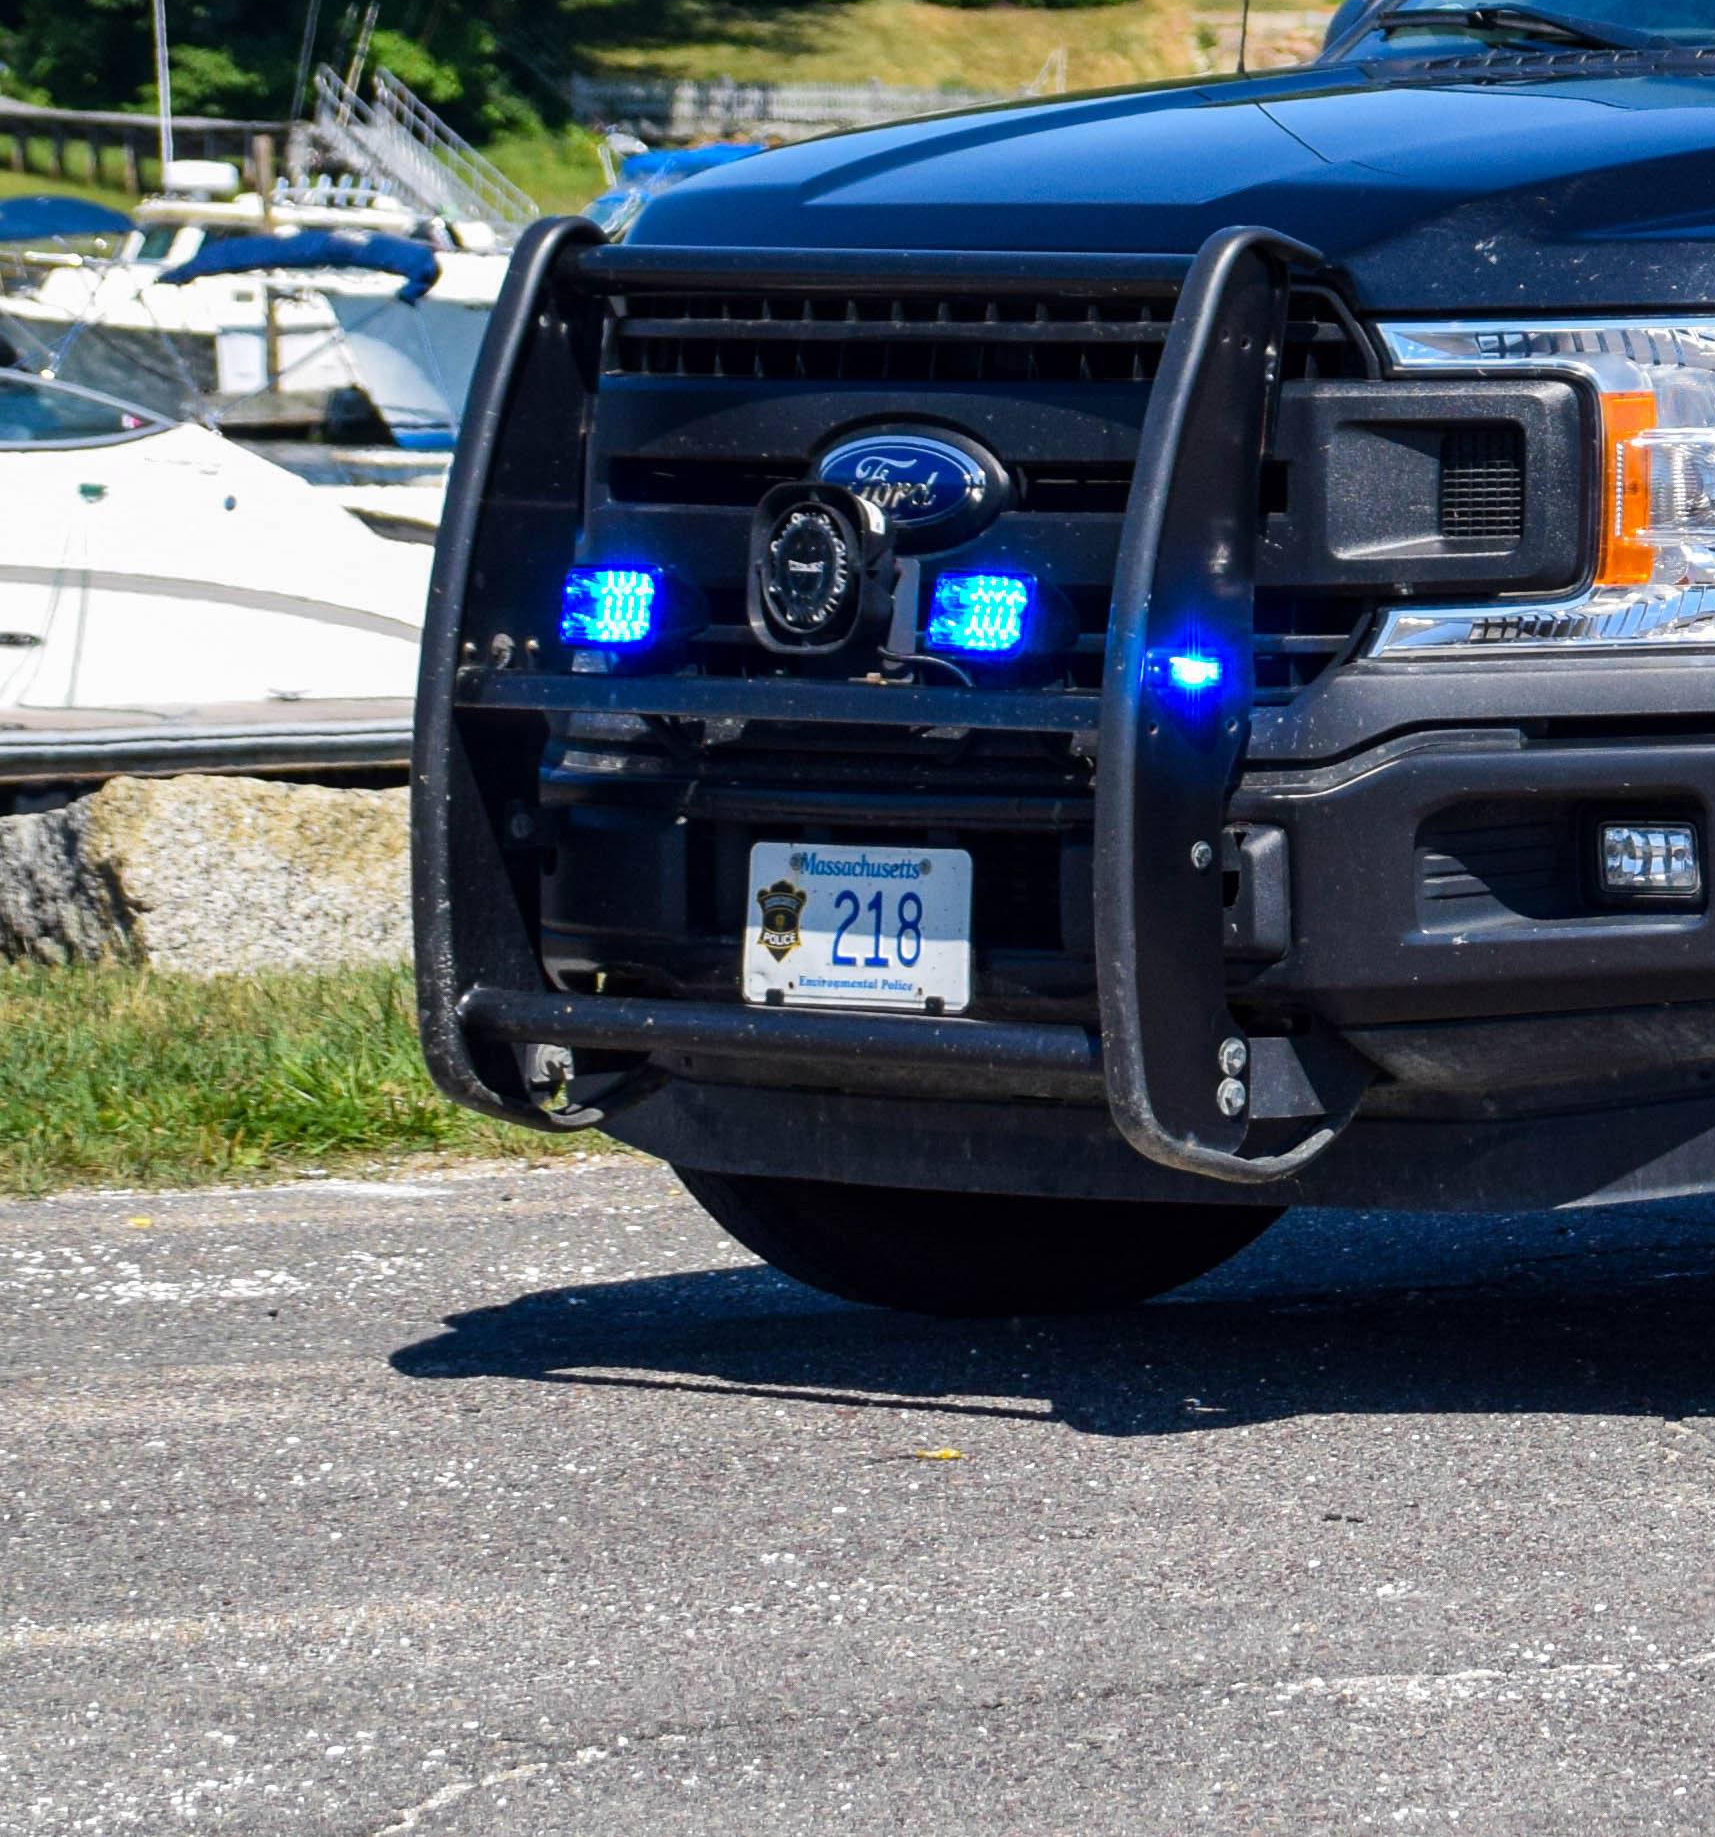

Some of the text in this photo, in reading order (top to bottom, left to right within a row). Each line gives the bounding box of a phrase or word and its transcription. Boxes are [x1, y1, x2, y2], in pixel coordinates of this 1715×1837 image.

[846, 455, 939, 509] Ford
[800, 852, 920, 880] Massachusetts
[763, 932, 797, 946] POLICE
[831, 889, 923, 968] 218
[799, 975, 913, 992] Environmental Police
